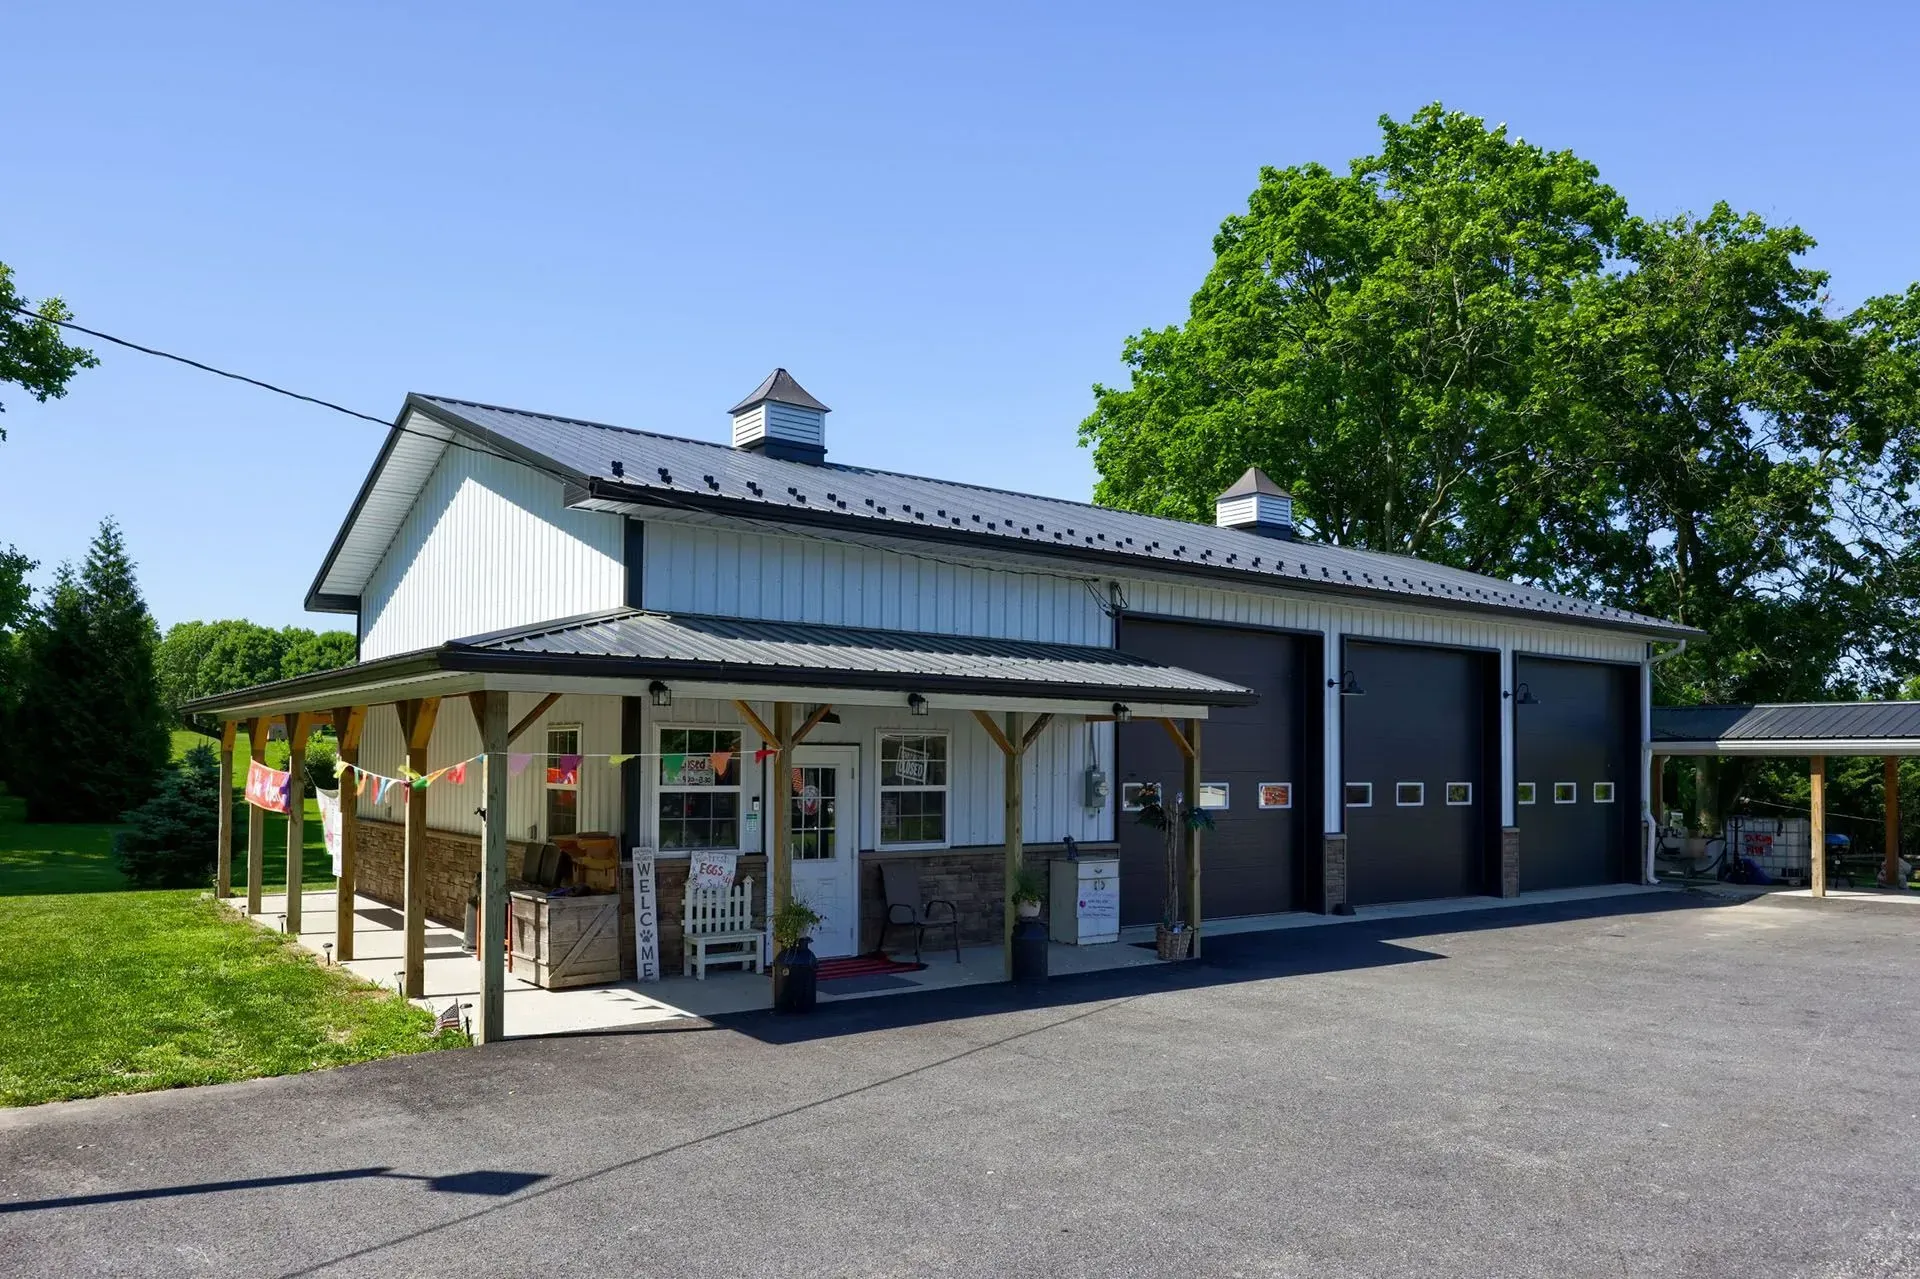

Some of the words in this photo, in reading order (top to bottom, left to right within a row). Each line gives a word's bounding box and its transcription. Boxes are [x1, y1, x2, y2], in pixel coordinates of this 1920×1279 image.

[898, 759, 923, 778] CLOSED
[699, 862, 725, 877] EGGS
[637, 863, 654, 977] WELCME
